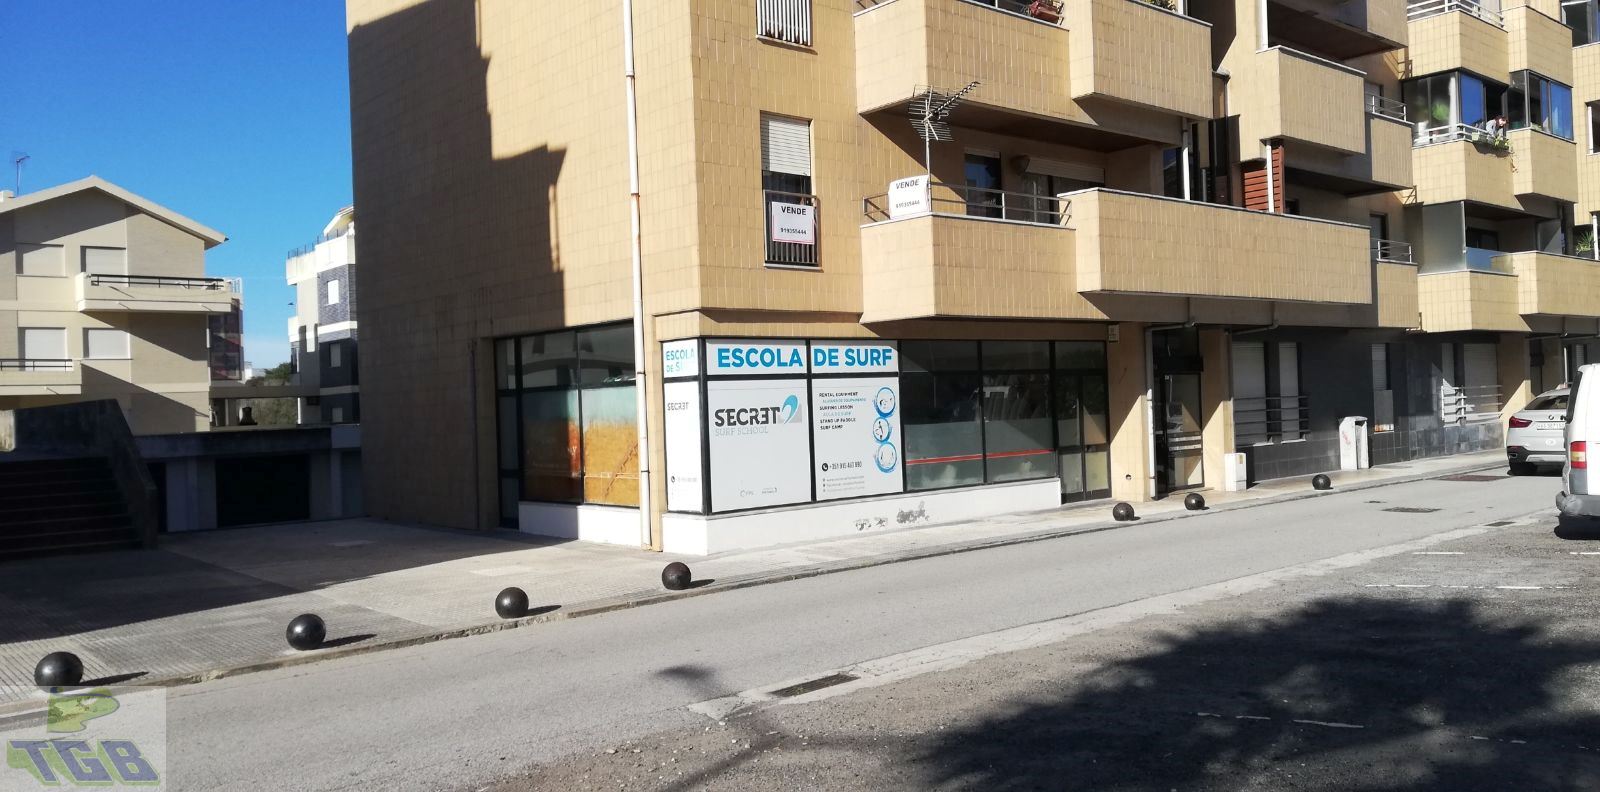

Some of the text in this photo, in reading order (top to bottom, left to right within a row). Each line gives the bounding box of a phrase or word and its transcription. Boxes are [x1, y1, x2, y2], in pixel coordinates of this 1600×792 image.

[895, 178, 920, 189] VENDE
[781, 206, 807, 216] VENDE
[666, 348, 695, 361] ESCOLA
[717, 347, 893, 368] ESCOLA DE SURF
[715, 426, 768, 437] SURF SCHOOL
